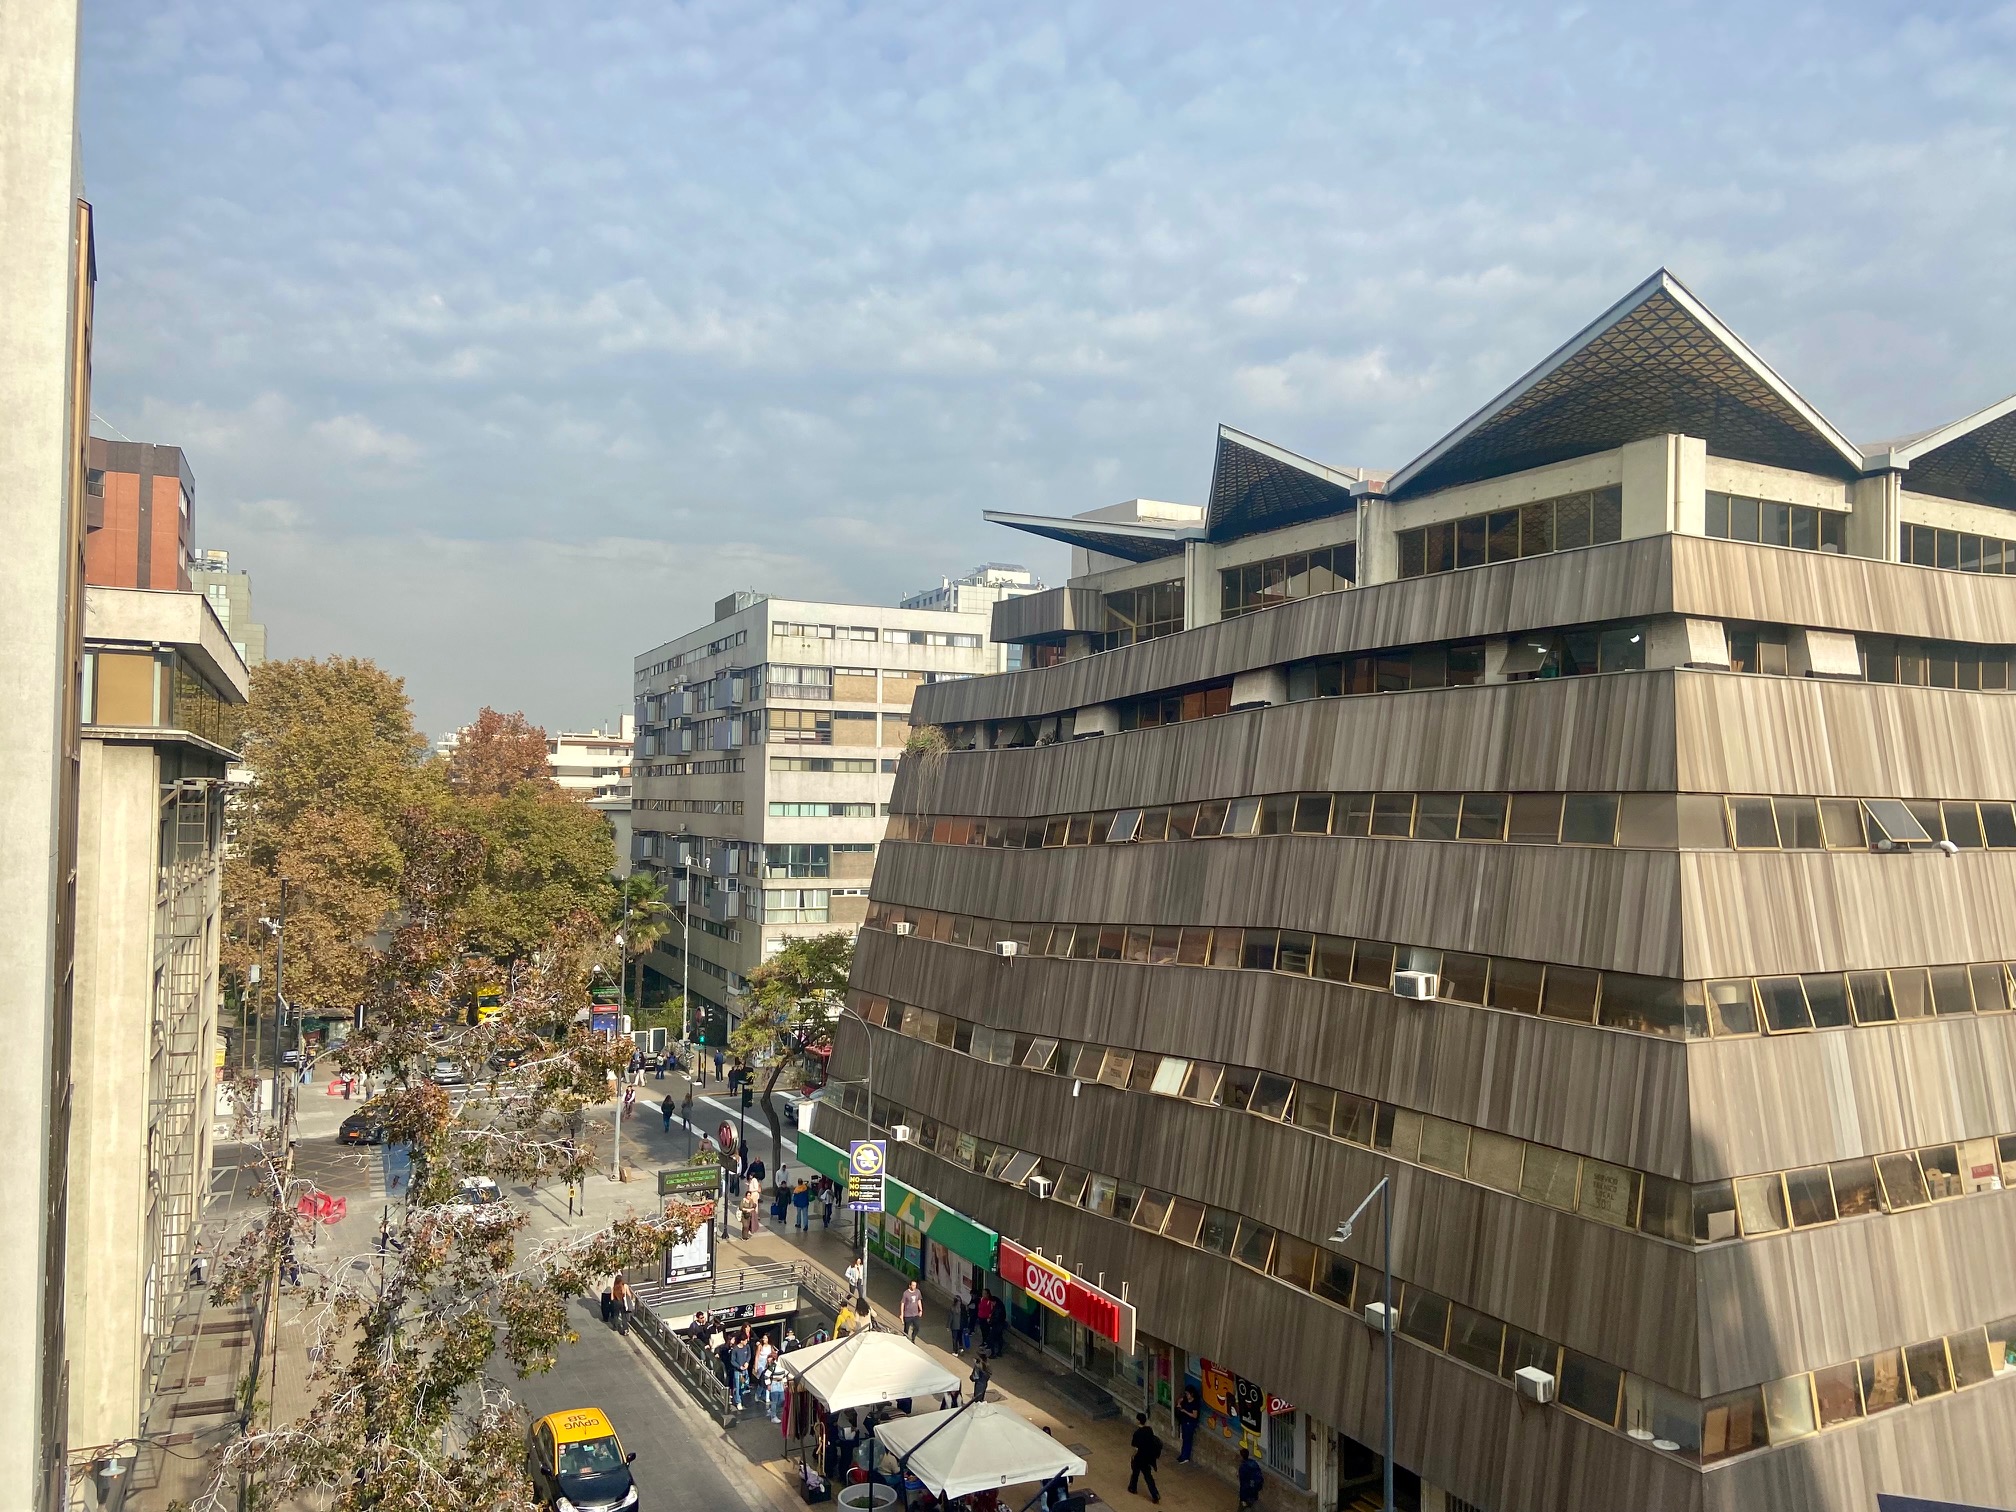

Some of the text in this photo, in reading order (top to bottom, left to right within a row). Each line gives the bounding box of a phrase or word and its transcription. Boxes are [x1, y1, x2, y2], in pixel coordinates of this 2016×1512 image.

[1595, 1189, 1614, 1201] LOCAL
[1026, 1265, 1066, 1305] OXXO
[564, 1418, 600, 1430] GPWG
[568, 1414, 587, 1422] 38
